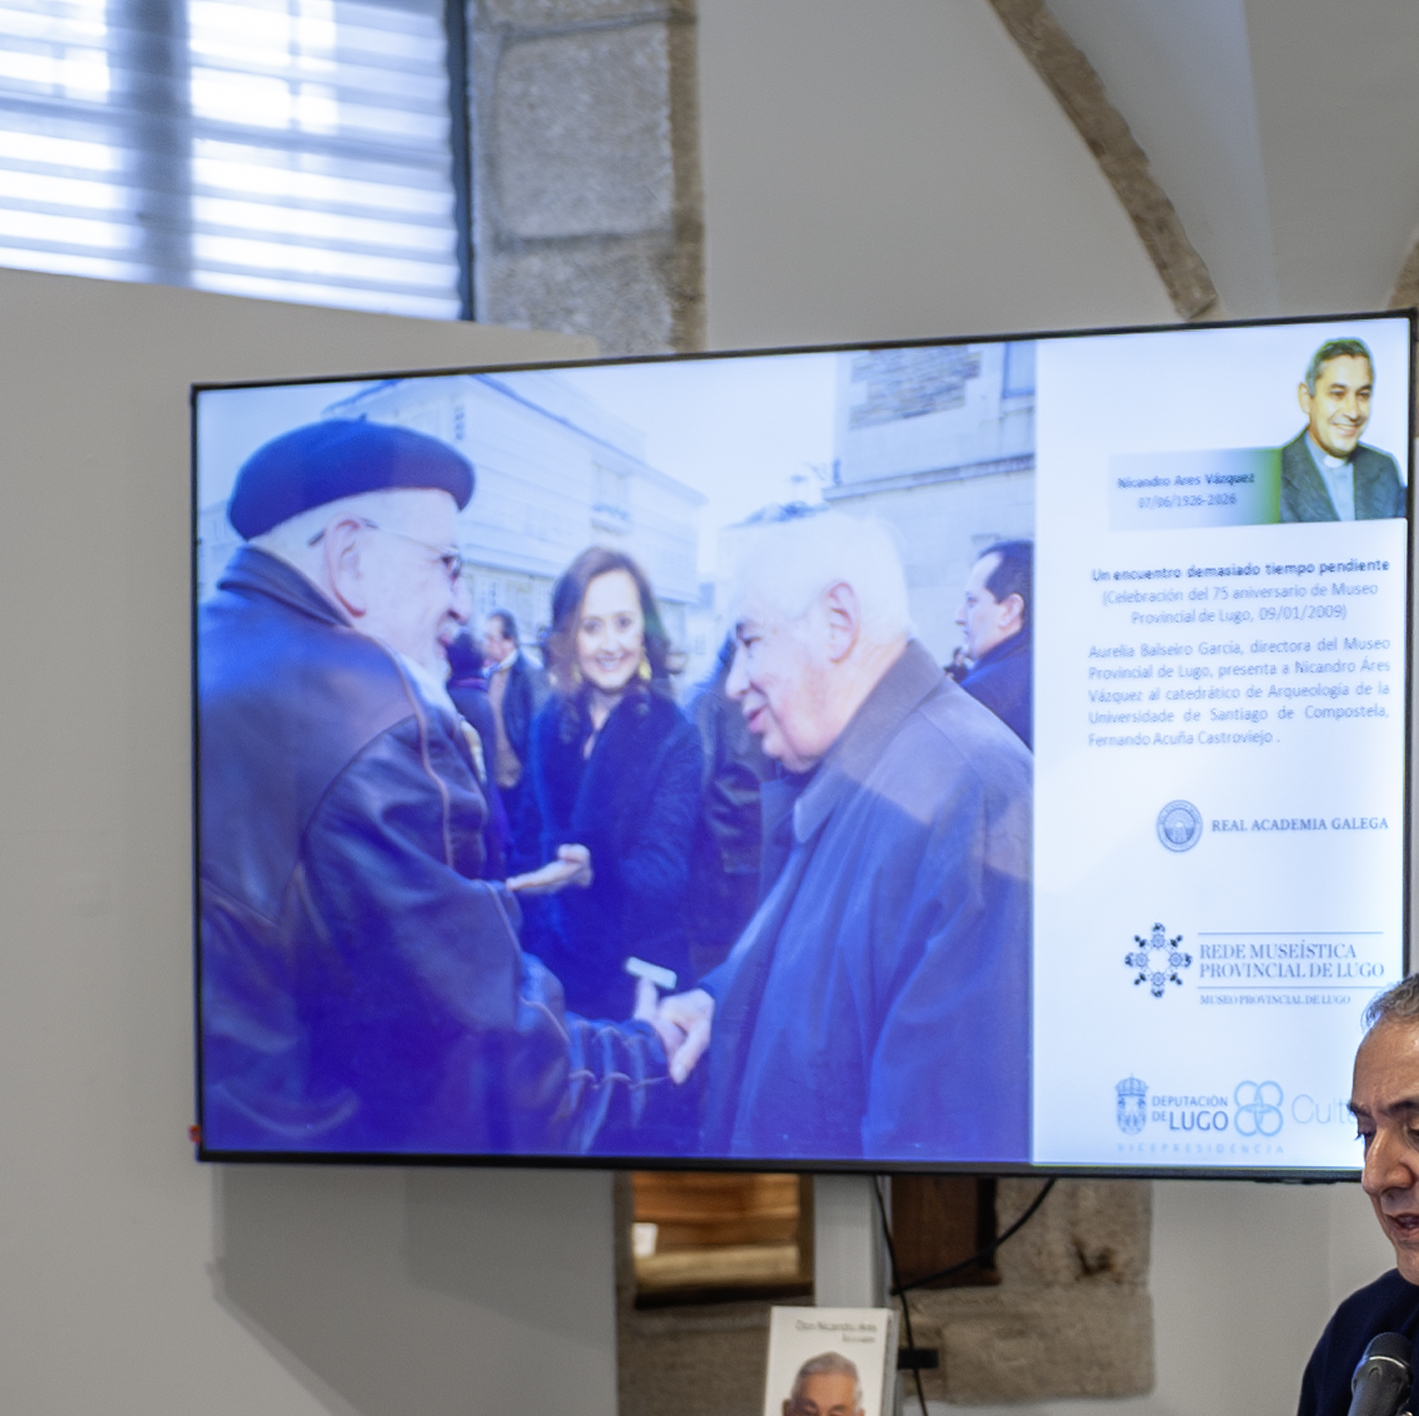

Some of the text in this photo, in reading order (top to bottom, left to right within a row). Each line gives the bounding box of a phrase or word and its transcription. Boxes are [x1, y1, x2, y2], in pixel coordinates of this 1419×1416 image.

[1092, 558, 1390, 581] Un encuentro demasiado tiempo pendiente
[1102, 582, 1378, 606] (Celebración del 75 aniversario de Museo
[1131, 603, 1347, 625] Provincial de Lugo, 09/01/2009)
[1088, 644, 1136, 659] Aurelia
[1140, 642, 1193, 657] Balseiro
[1250, 639, 1311, 655] directora
[1317, 637, 1338, 651] del
[1343, 637, 1390, 651] Museo
[1088, 664, 1153, 679] Provincial
[1157, 665, 1175, 679] de
[1178, 665, 1213, 681] Lugo,
[1217, 664, 1277, 680] presenta
[1295, 660, 1355, 675] Nicandro
[1148, 688, 1161, 701] al
[1165, 686, 1241, 701] catedrático
[1246, 685, 1263, 699] de
[1355, 682, 1373, 696] de
[1378, 681, 1391, 695] la
[1088, 703, 1389, 724] Universidade de Santiago de Compostela,
[1088, 730, 1274, 746] Fernando Acuña Castroviejo
[1212, 817, 1389, 832] REAL ACADEMIA GALEGA
[1199, 939, 1358, 960] REDE MUSEÍSTICA
[1200, 961, 1385, 979] PROVINCIAL DE LUGO
[1200, 994, 1351, 1005] MUSEO PROVINCIAL DE LUGO
[1152, 1094, 1228, 1108] DEPUTACIÓN
[1291, 1093, 1352, 1125] Cult
[1152, 1110, 1229, 1131] DE LUGO
